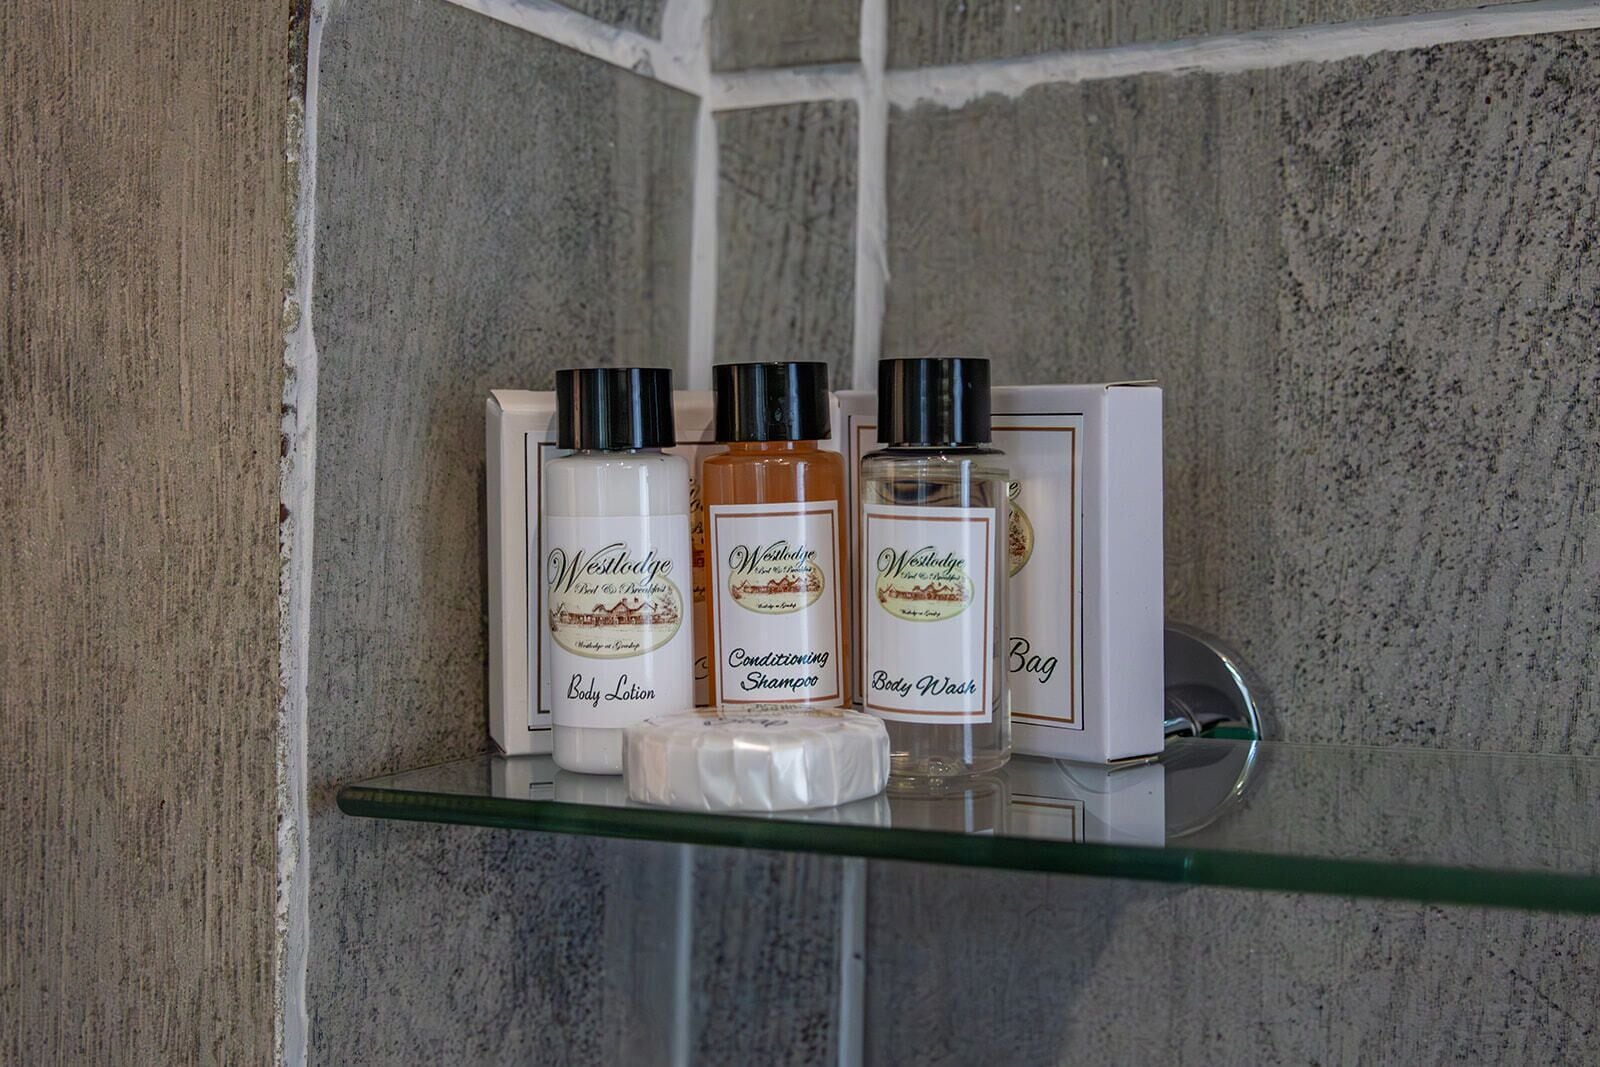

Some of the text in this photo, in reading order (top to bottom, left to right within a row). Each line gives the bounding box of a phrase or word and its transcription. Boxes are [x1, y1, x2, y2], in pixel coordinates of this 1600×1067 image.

[547, 542, 672, 593] Westlodge
[728, 540, 816, 575] Westlodge
[877, 545, 965, 578] Westlodge
[574, 583, 599, 594] Bed
[619, 582, 666, 595] Breakfast
[728, 648, 829, 668] Conditioning
[1009, 637, 1058, 683] Bag
[567, 673, 656, 708] Body Lotion
[740, 671, 818, 693] Shampoo
[872, 670, 976, 697] Body Wash
